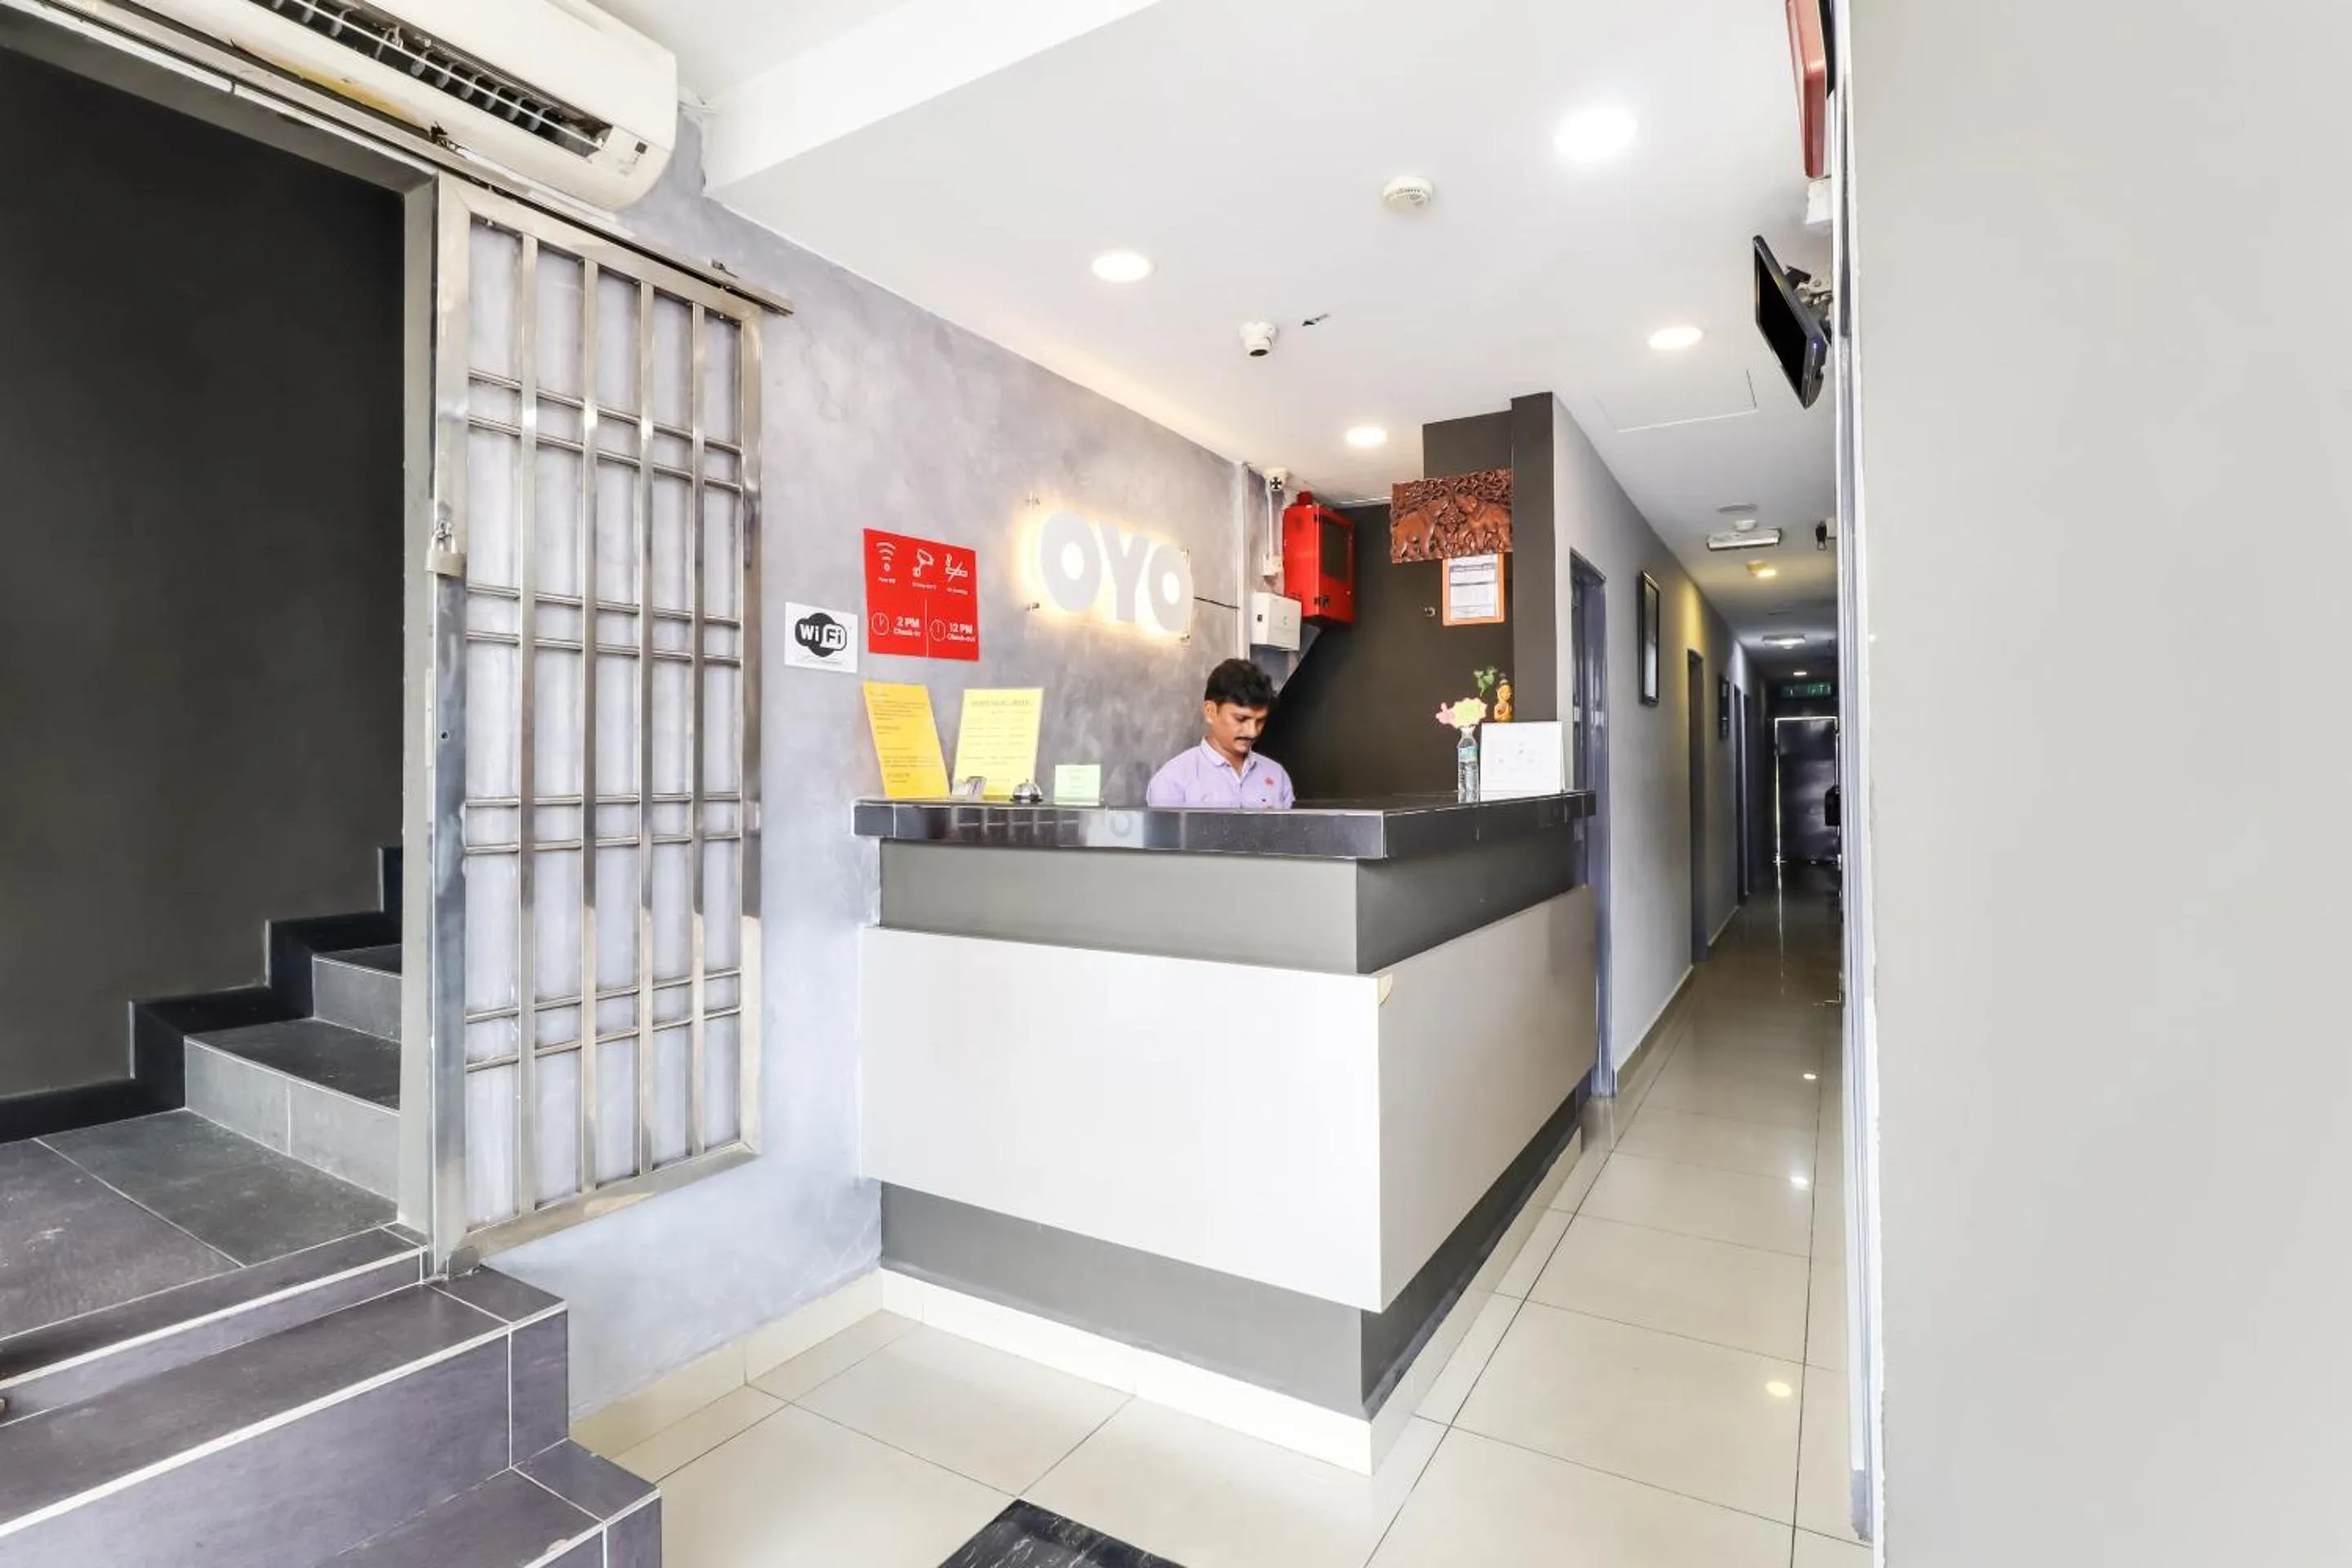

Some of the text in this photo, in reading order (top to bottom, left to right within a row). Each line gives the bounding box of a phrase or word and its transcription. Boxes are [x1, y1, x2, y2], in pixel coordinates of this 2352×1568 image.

[1040, 511, 1193, 632] OYO
[896, 616, 920, 628] 2 PM
[949, 622, 973, 635] 12 PM
